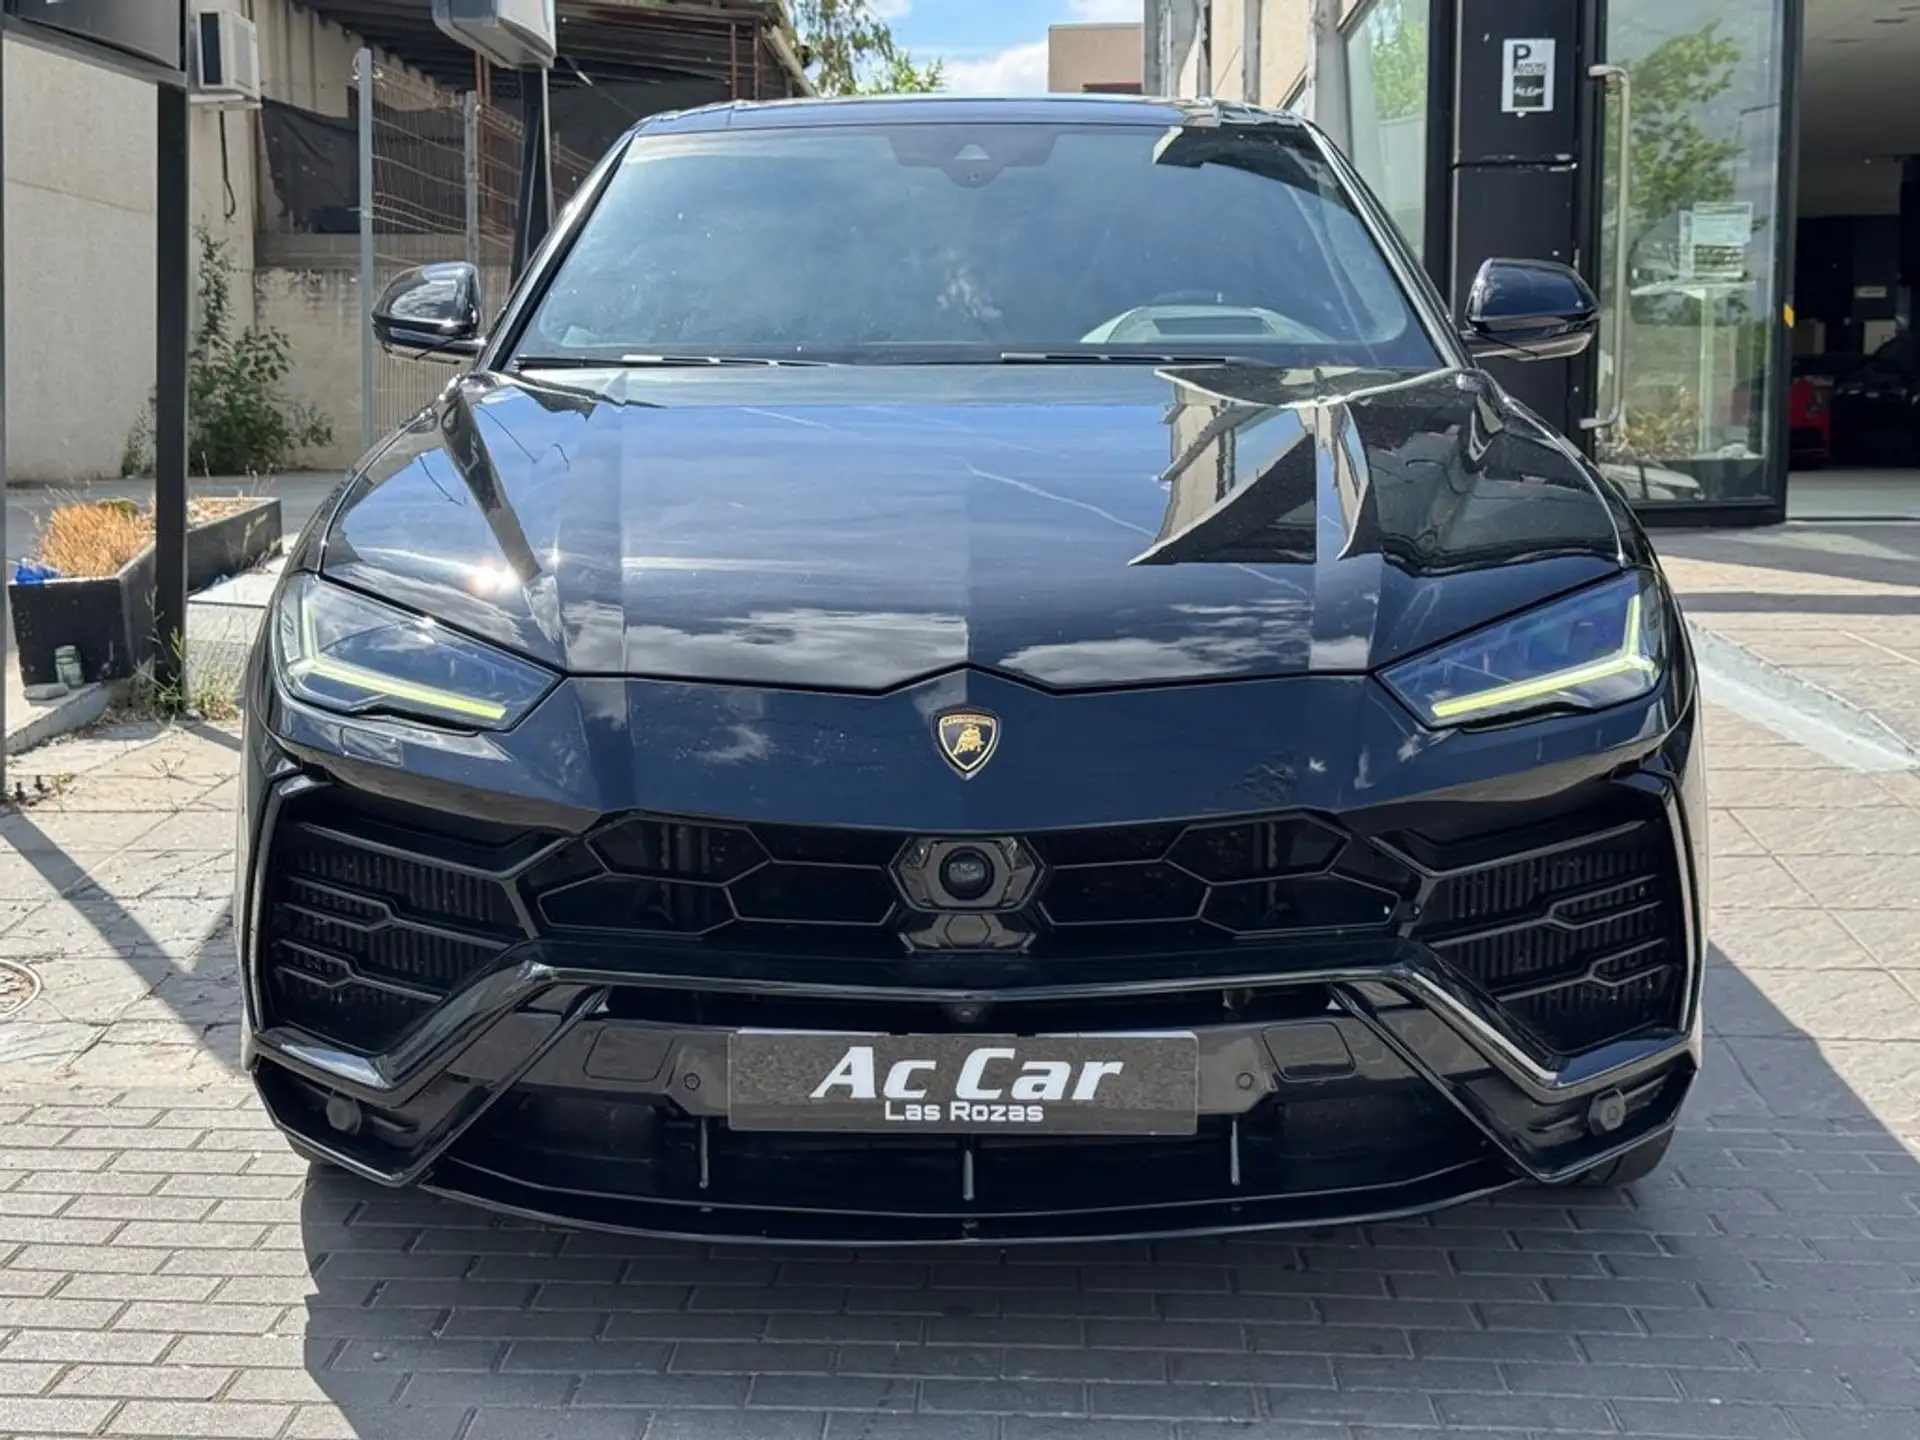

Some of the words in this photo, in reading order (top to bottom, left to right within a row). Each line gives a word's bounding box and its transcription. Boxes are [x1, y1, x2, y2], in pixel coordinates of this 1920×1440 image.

[1513, 44, 1531, 69] P
[809, 1046, 937, 1099] Ac
[955, 1047, 1124, 1101] Car
[885, 1101, 941, 1121] Las
[950, 1101, 1044, 1122] Rozas
